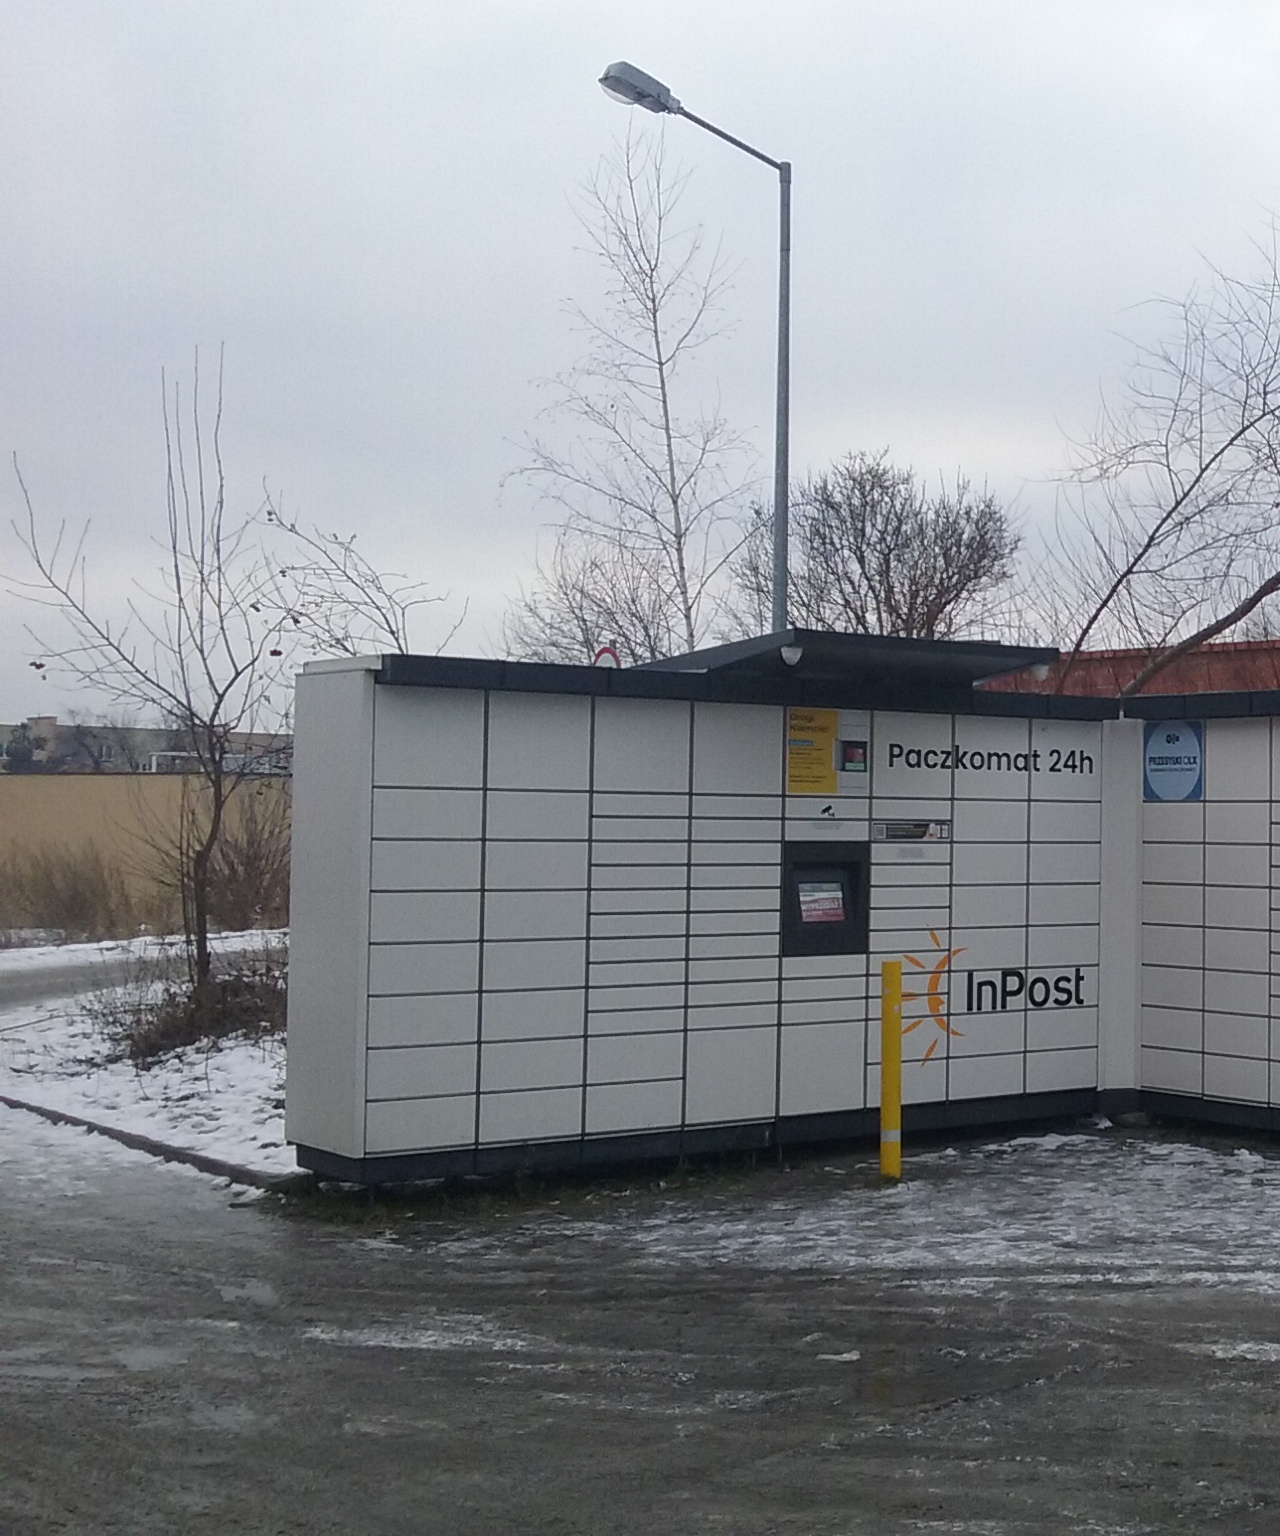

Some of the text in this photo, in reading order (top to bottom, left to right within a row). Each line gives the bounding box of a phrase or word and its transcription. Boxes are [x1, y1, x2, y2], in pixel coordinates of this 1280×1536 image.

[888, 743, 1094, 775] Paczkomat 24h
[966, 967, 1085, 1012] InPost
